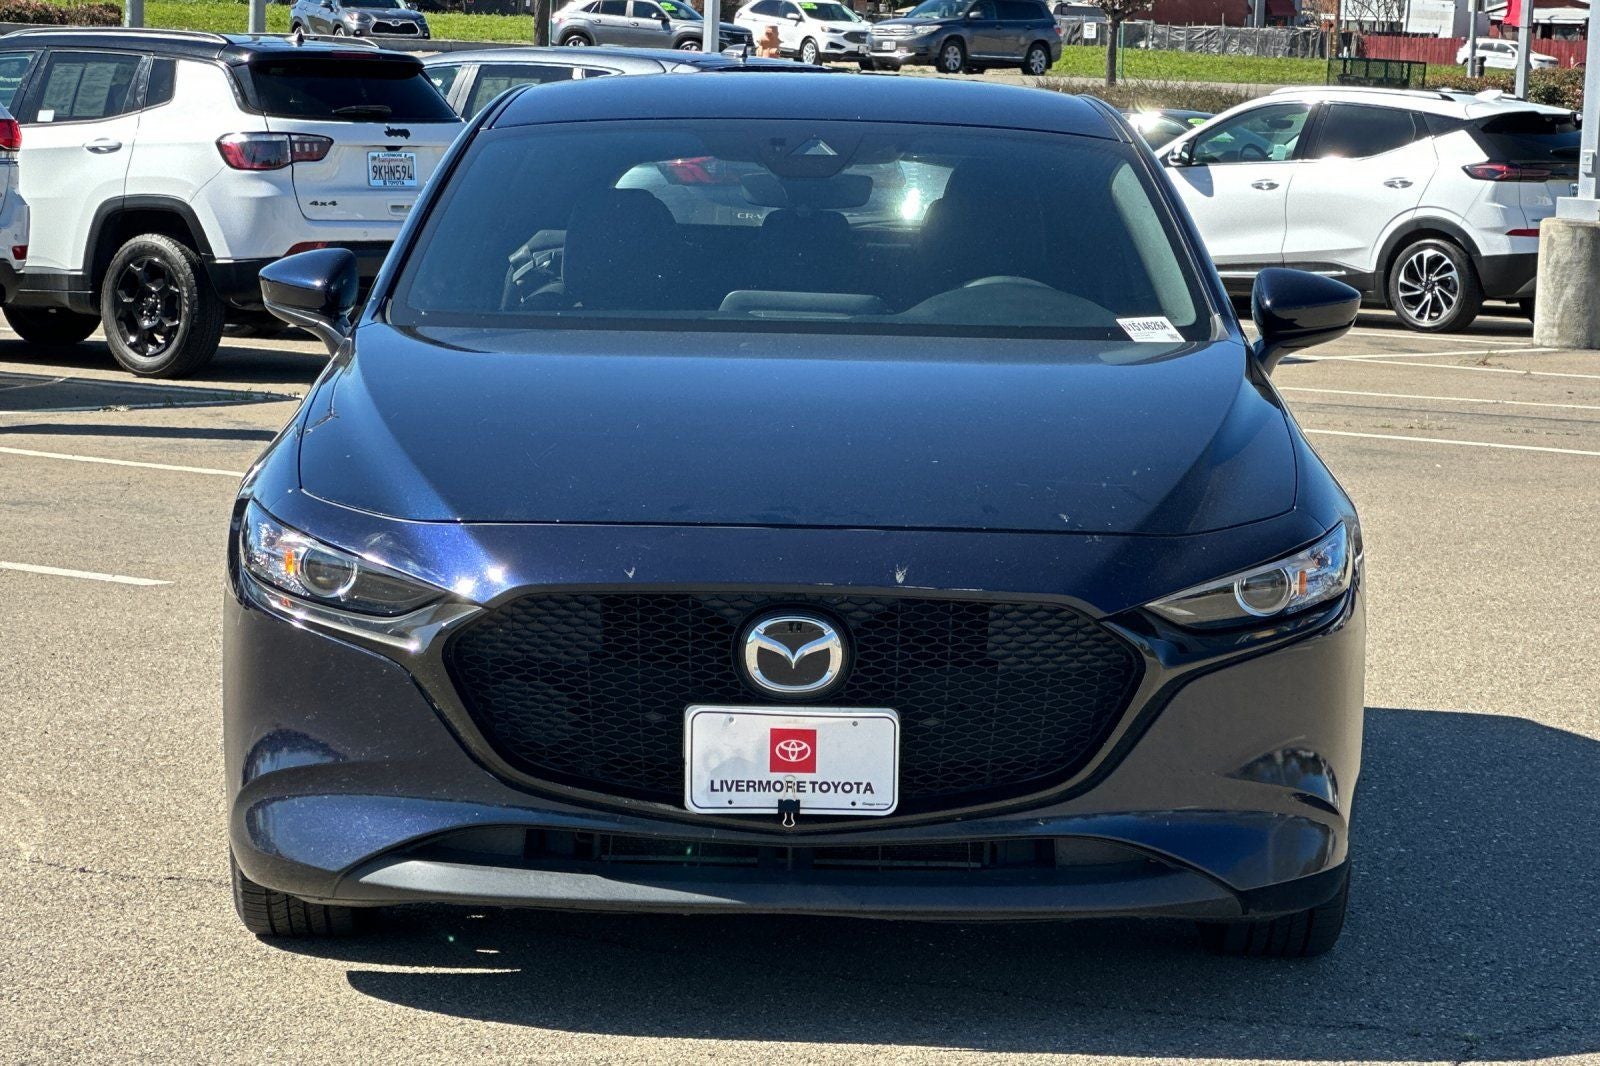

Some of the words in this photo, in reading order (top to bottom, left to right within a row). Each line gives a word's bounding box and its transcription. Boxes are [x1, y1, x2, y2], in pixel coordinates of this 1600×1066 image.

[372, 165, 413, 180] 9KHN594
[710, 779, 807, 793] LIVERMORE
[811, 781, 875, 795] TOYOTA
